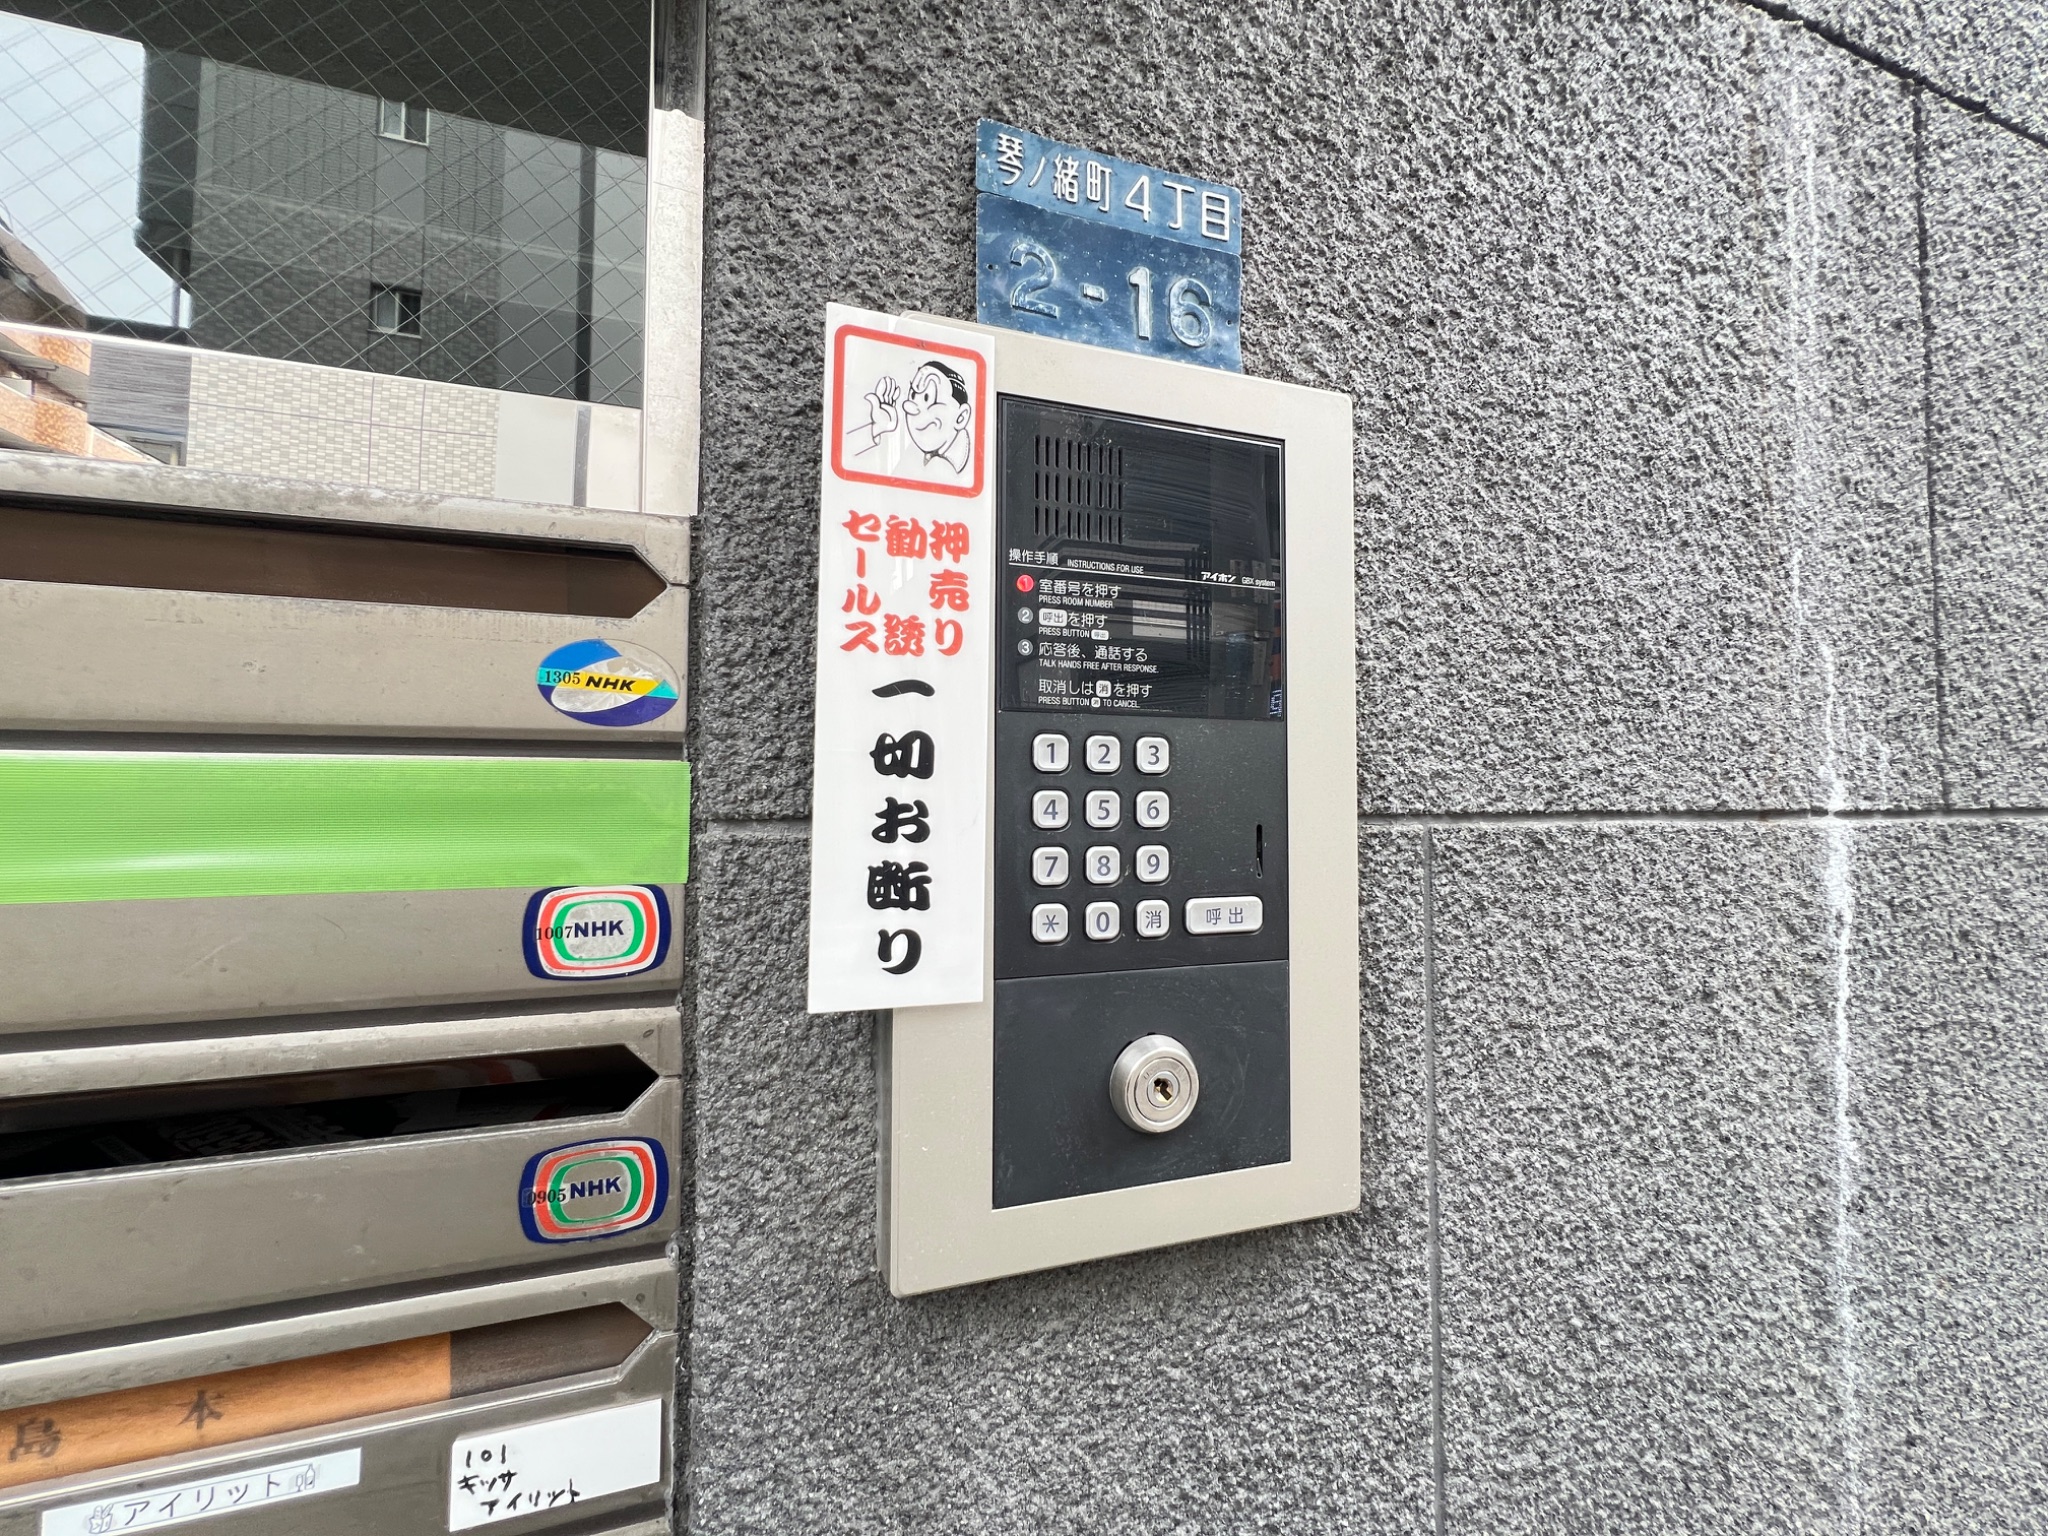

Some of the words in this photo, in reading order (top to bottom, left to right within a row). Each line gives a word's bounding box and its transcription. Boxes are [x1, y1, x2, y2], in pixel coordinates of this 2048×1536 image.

[996, 132, 1231, 242] 琴ノ緒町4丁目
[1009, 242, 1213, 348] 2-16
[1009, 548, 1059, 566] 操作手順
[1067, 559, 1115, 572] INSTRUCTIONS
[1116, 564, 1130, 572] FOR
[1131, 565, 1144, 574] USE
[840, 509, 882, 653] セールス
[884, 514, 929, 657] 勧誘
[929, 519, 970, 657] 押売り
[1201, 571, 1237, 583] アイホン
[1255, 578, 1276, 587] system
[1039, 579, 1122, 599] 室番号を押す
[1038, 595, 1061, 605] PRESS
[1062, 597, 1084, 607] ROOM
[1038, 627, 1061, 636] PRESS
[1062, 629, 1090, 638] BUTTON
[1038, 642, 1148, 662] 応答後、通話する
[1039, 658, 1057, 668] TALK
[1058, 660, 1082, 669] HANDS
[1083, 662, 1100, 670] FREE
[1101, 663, 1122, 672] AFTER
[544, 670, 581, 685] 1305
[585, 675, 636, 692] NHK
[1038, 695, 1061, 704] PRESS
[1062, 697, 1090, 706] BUTTON
[1103, 698, 1112, 707] TO
[1046, 742, 1056, 764] 1
[1097, 743, 1111, 765] 2
[1147, 744, 1160, 766] 3
[1043, 799, 1059, 821] 4
[1097, 799, 1110, 821] 5
[1146, 799, 1160, 820] 6
[866, 678, 936, 976] 一切お断り
[1044, 855, 1059, 878] 7
[1096, 855, 1111, 877] 8
[1146, 854, 1160, 875] 9
[1096, 911, 1110, 933] 0
[1145, 909, 1163, 930] 消
[1206, 906, 1244, 926] 呼出
[536, 926, 573, 941] 1007
[574, 919, 624, 939] NHK
[570, 1176, 622, 1200] NHK
[465, 1443, 507, 1468] 101
[123, 1473, 281, 1527] アイリット
